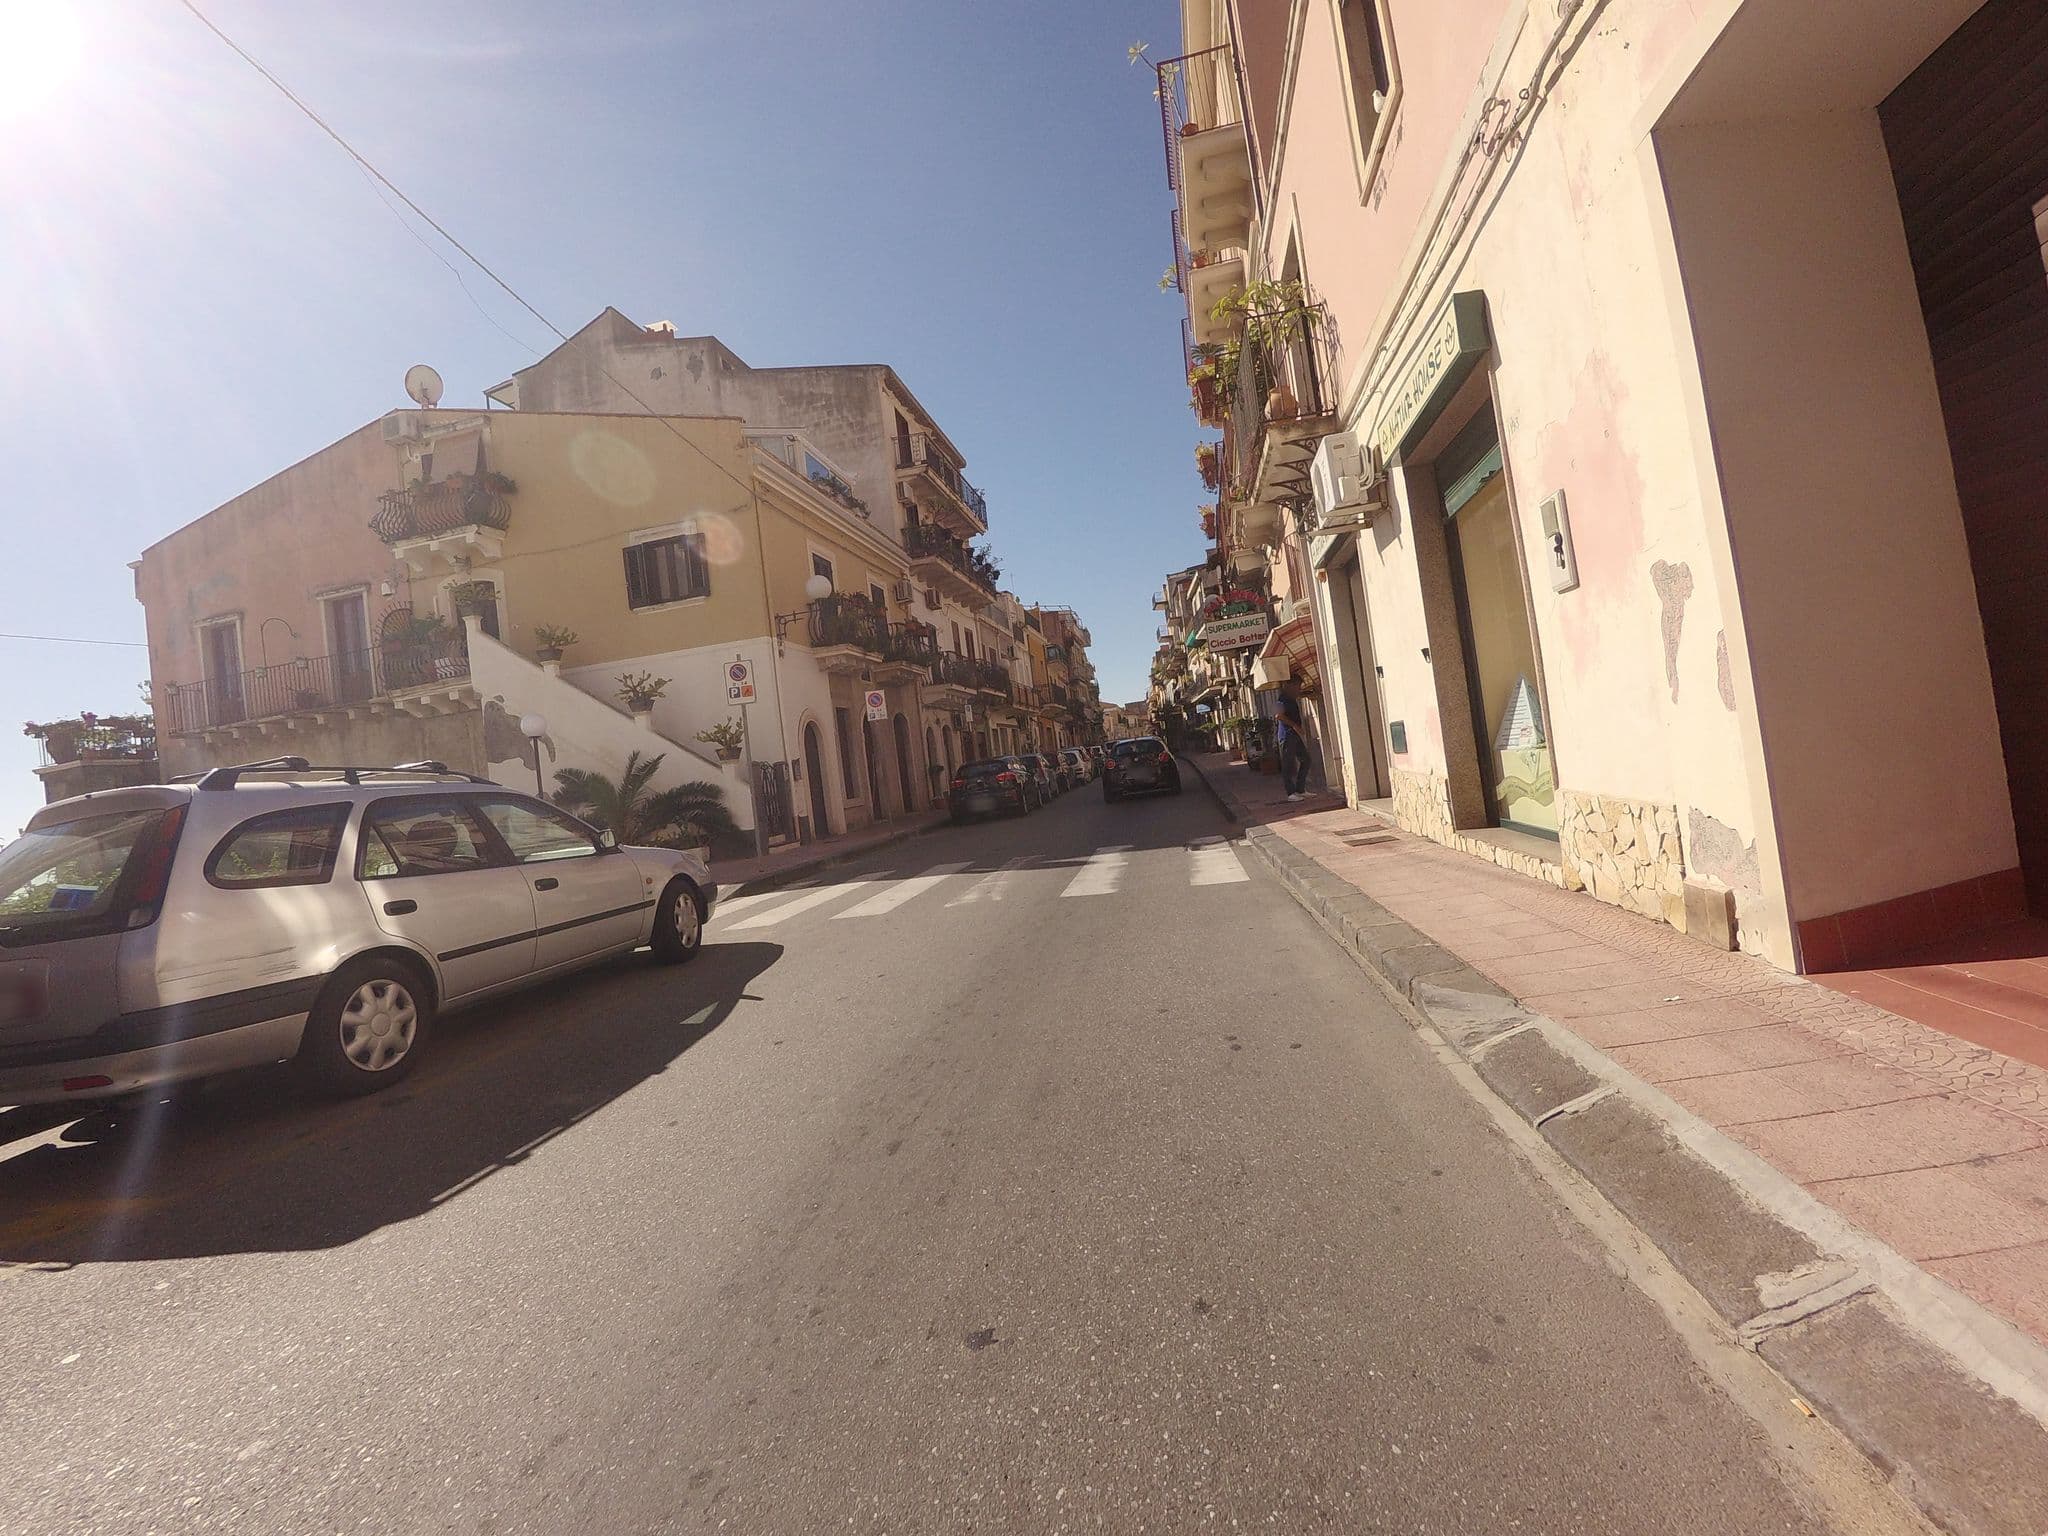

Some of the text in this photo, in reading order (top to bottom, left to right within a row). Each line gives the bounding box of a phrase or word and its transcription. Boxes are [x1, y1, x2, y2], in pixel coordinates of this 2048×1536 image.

[1412, 338, 1442, 403] HOUSE
[1208, 618, 1265, 634] SUPERMARKET
[1210, 636, 1237, 648] Ciccio
